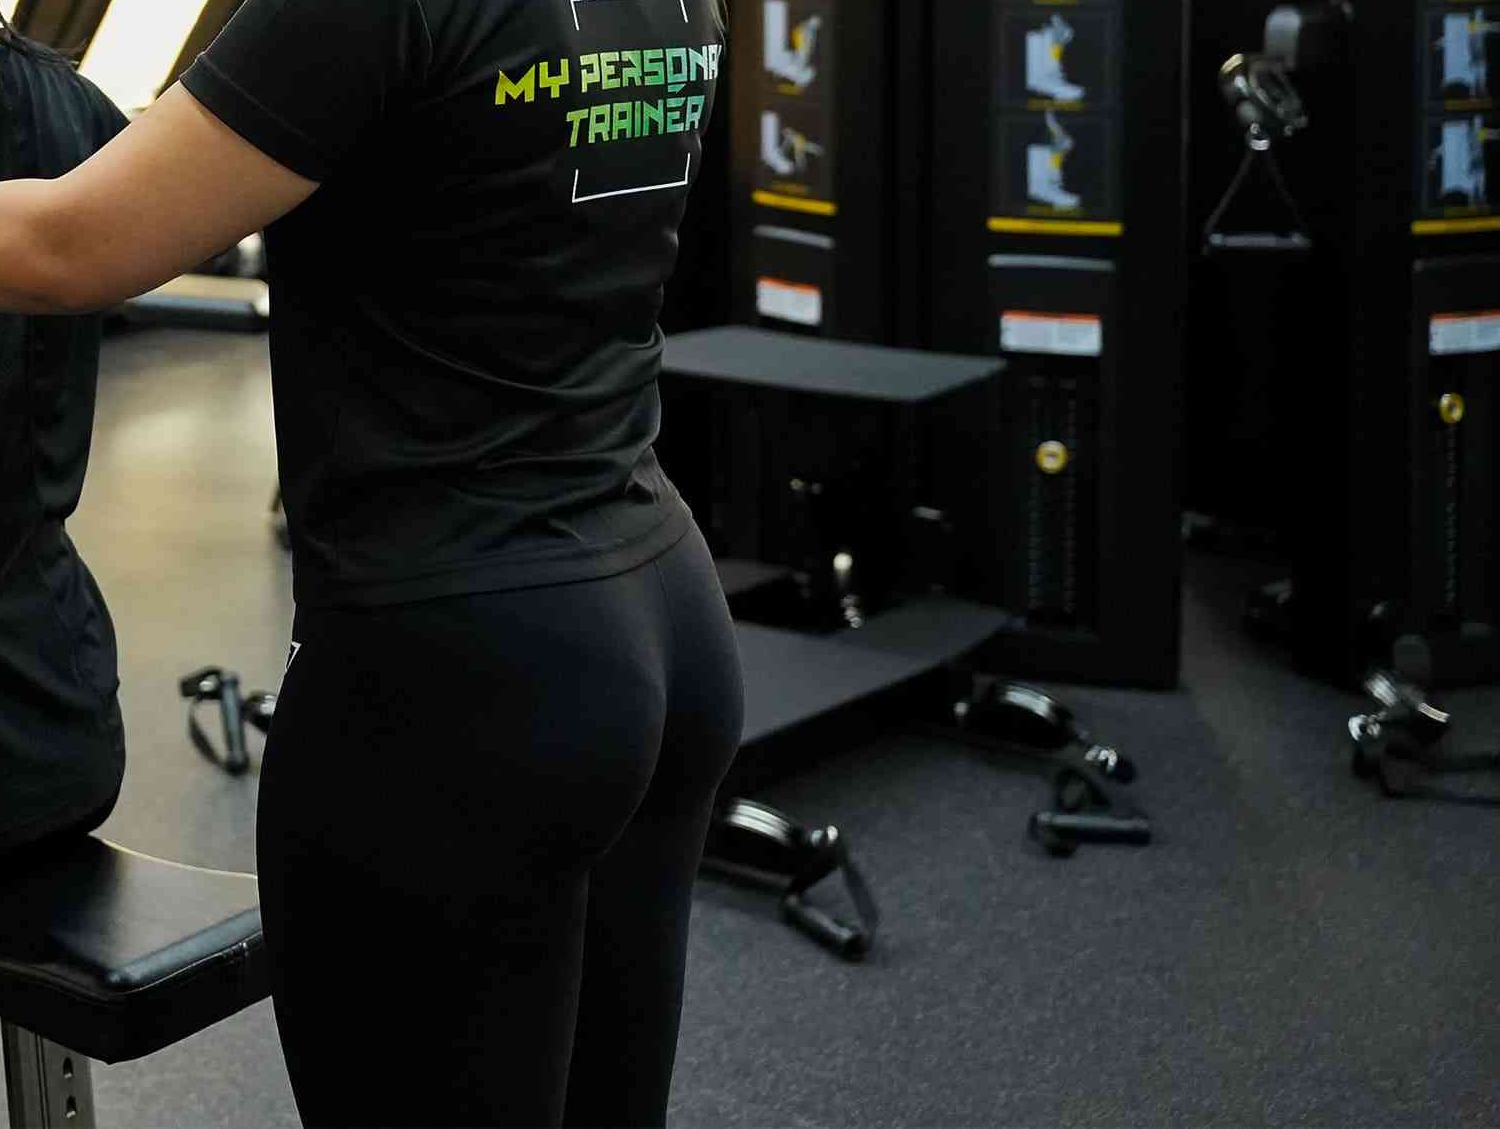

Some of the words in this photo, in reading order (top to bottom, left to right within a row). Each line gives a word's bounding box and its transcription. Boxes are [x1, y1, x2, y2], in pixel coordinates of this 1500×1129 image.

[495, 58, 570, 105] MY
[579, 44, 723, 93] PERSONA
[566, 94, 705, 148] TRAINER
